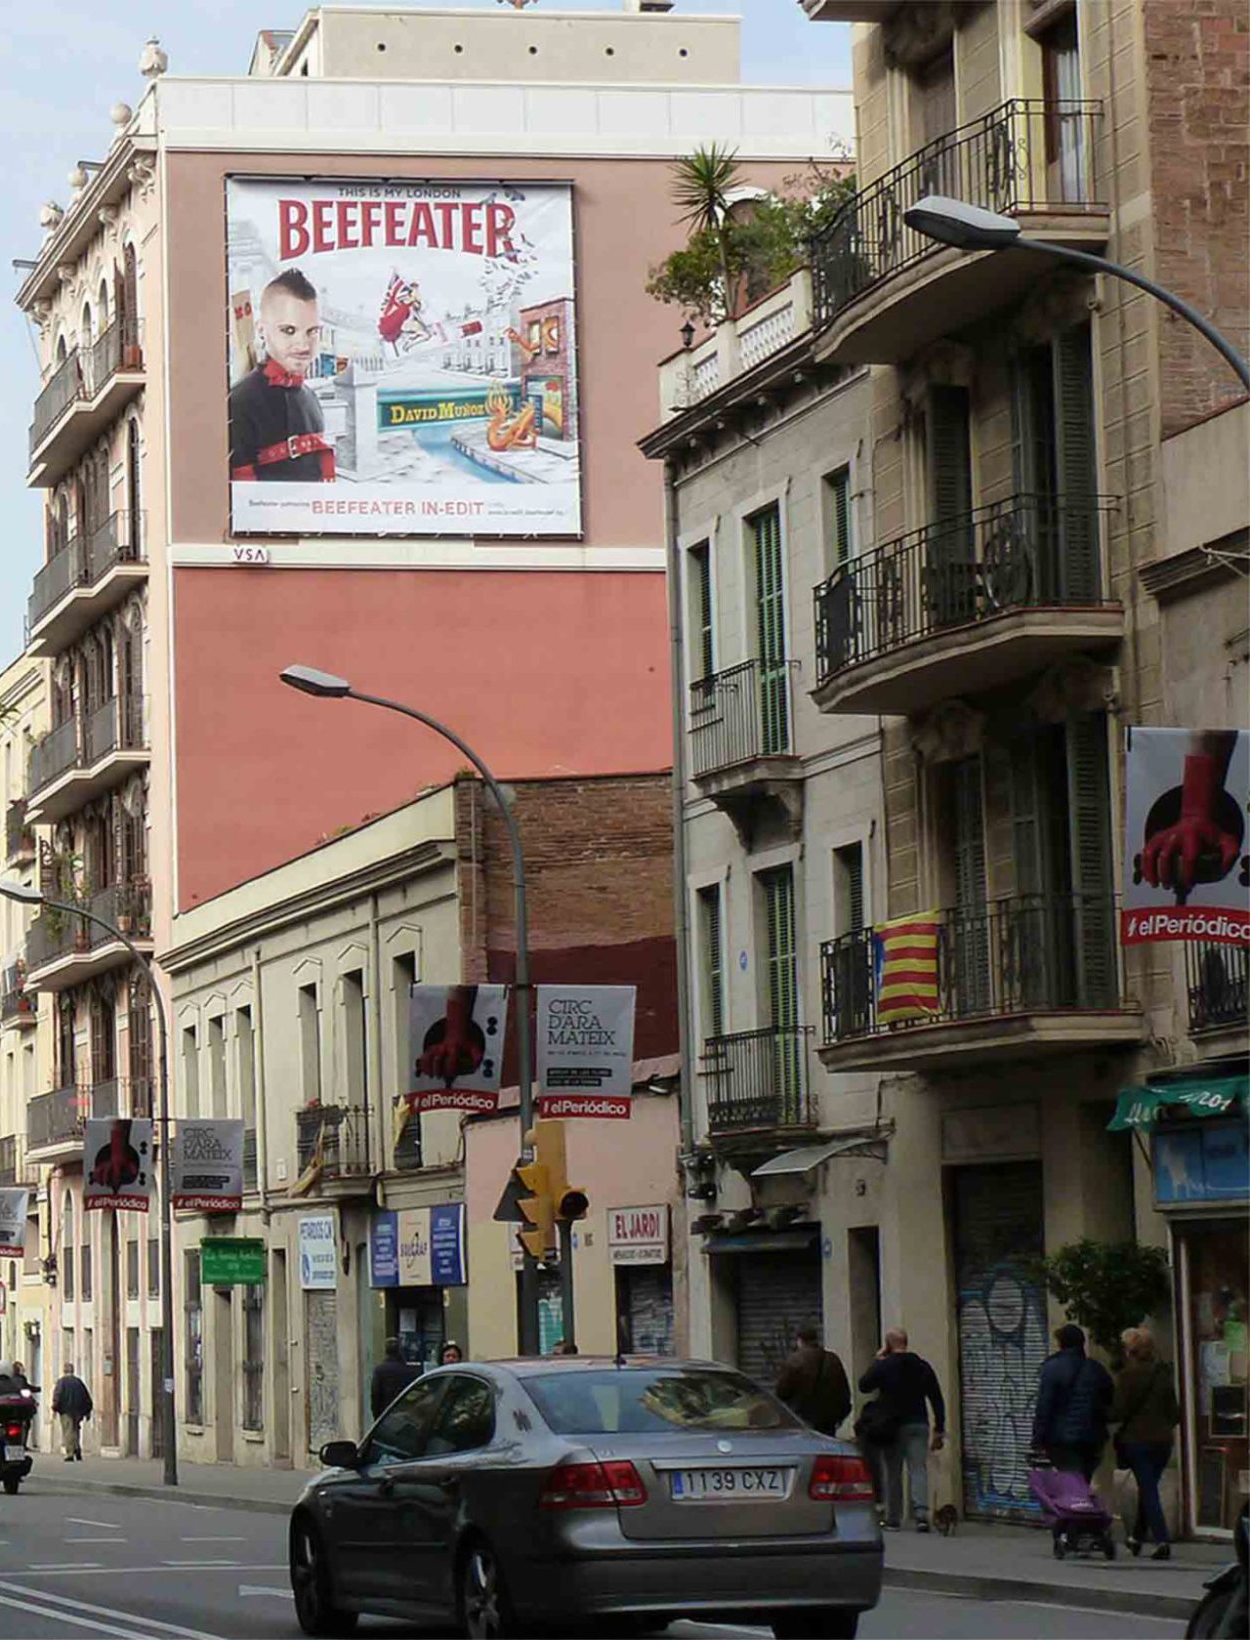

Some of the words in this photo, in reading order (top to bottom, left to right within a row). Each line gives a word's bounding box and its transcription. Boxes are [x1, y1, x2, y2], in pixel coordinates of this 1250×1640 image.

[338, 187, 366, 197] THIS
[369, 187, 381, 198] IS
[384, 188, 403, 198] MY
[406, 188, 461, 199] LONDON
[278, 199, 519, 264] BEEFEATER
[311, 500, 416, 515] BEEFEATER
[421, 501, 484, 516] IN-EDIT
[1138, 914, 1250, 940] elPeriódico
[548, 999, 592, 1015] CIRC
[548, 1030, 616, 1046] MATEIX
[422, 1092, 494, 1110] elPeriódico
[550, 1099, 627, 1116] elPeriódico
[615, 1214, 628, 1239] EL
[687, 1471, 735, 1492] 1139
[741, 1470, 780, 1491] CXZ
